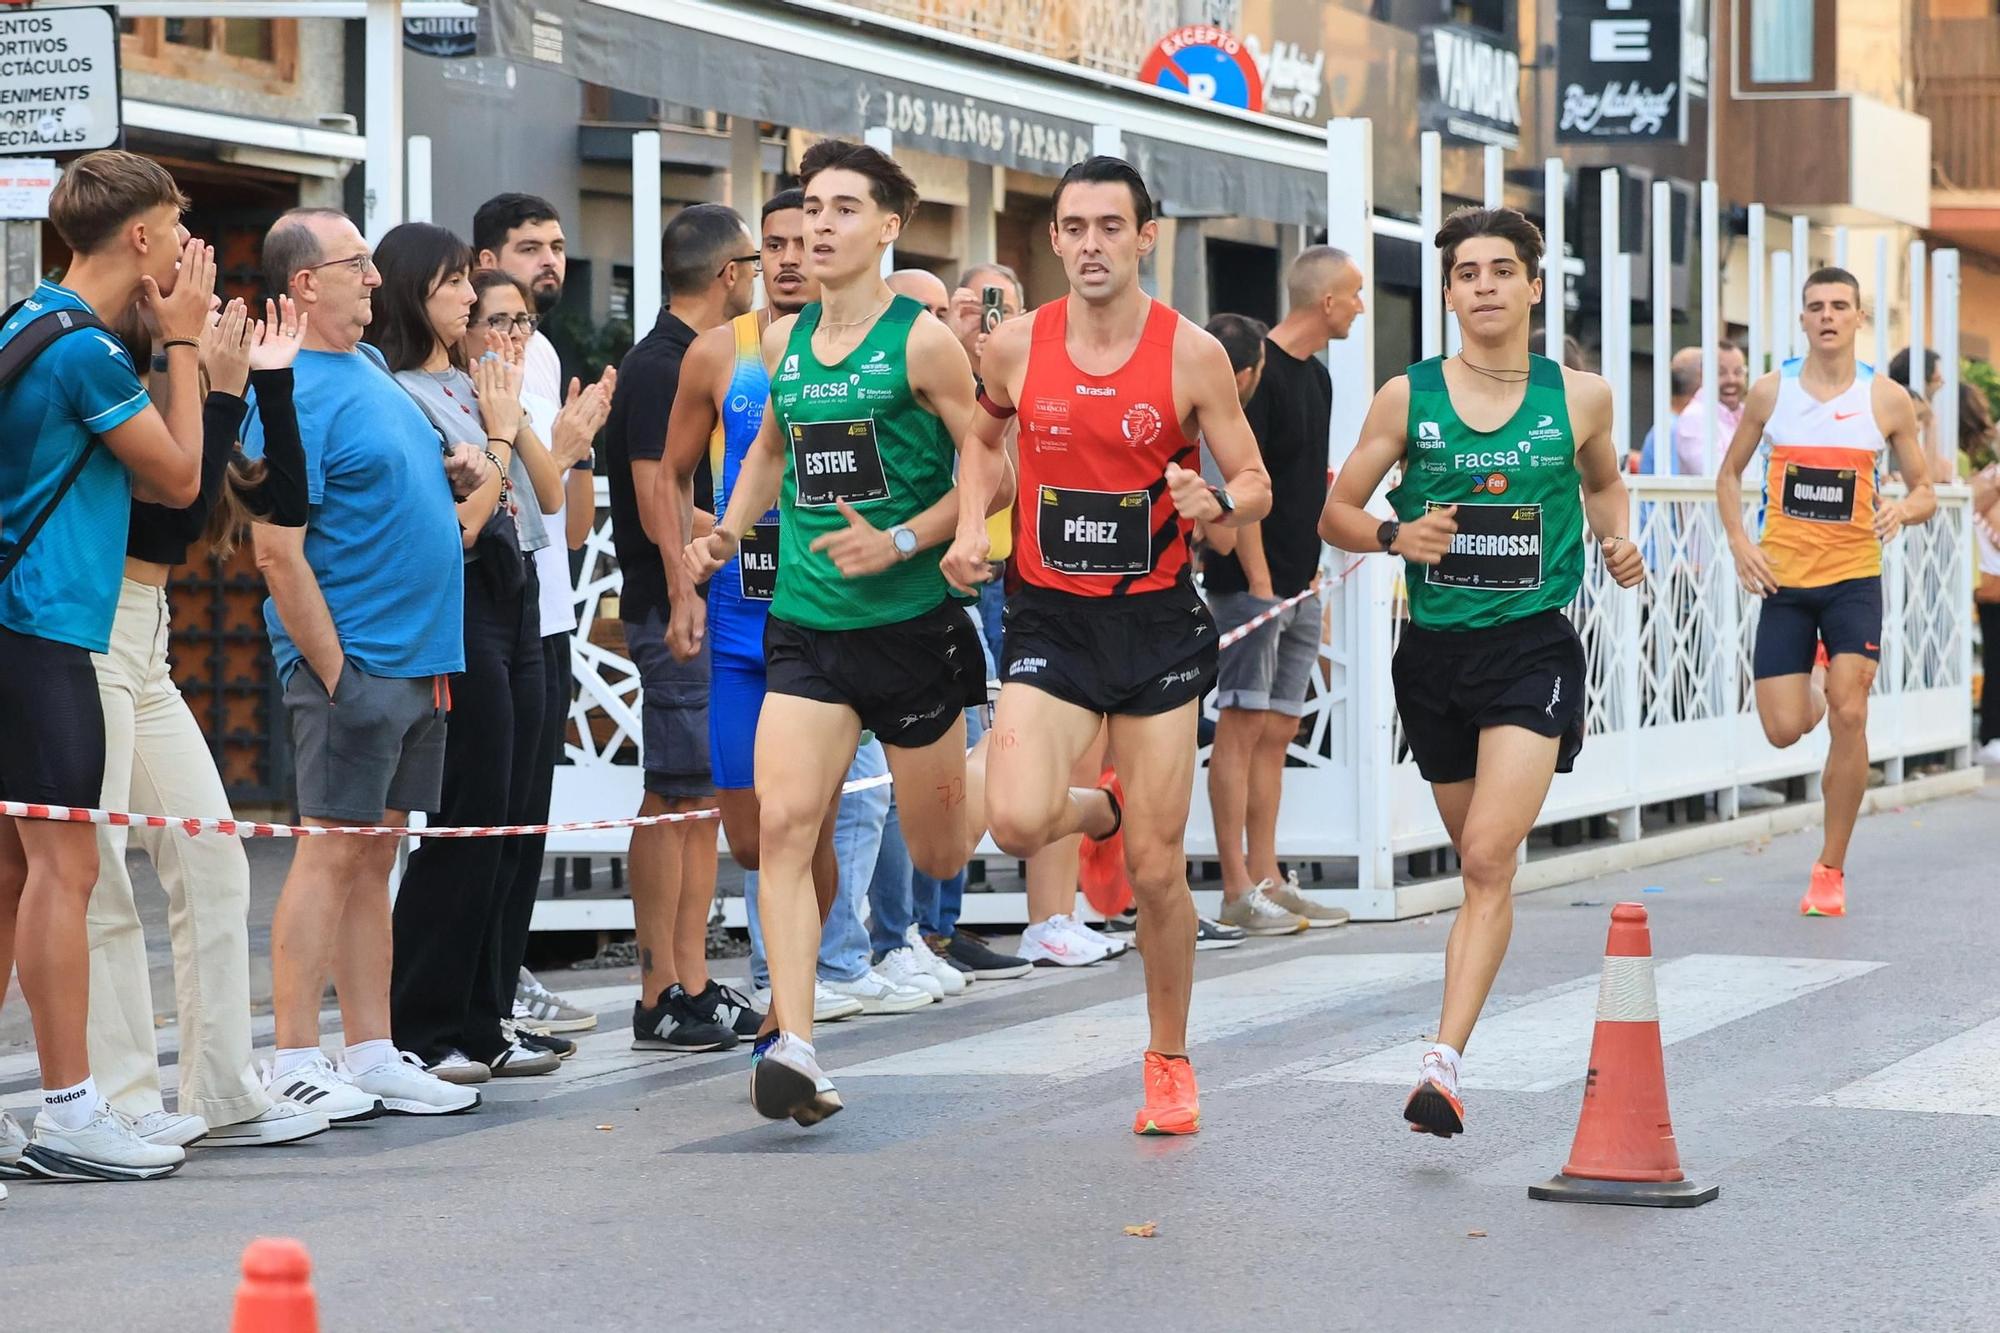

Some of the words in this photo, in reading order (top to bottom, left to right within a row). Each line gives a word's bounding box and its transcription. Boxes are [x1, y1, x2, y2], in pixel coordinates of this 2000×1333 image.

[1160, 26, 1240, 57] EXCEPTO
[1591, 19, 1652, 62] E
[0, 58, 93, 76] CTÁCULOS
[885, 91, 928, 136] LOS
[930, 98, 1005, 151] MAÑOS
[1008, 117, 1070, 165] TAPAS
[803, 382, 848, 399] Facsa
[805, 450, 858, 476] ESTEVE
[1454, 450, 1520, 469] Facsa
[1488, 478, 1505, 488] Fer
[1794, 483, 1844, 503] QUIJADA
[1064, 515, 1118, 544] PÉREZ
[743, 551, 776, 572] M.EL
[45, 1088, 87, 1104] adidas
